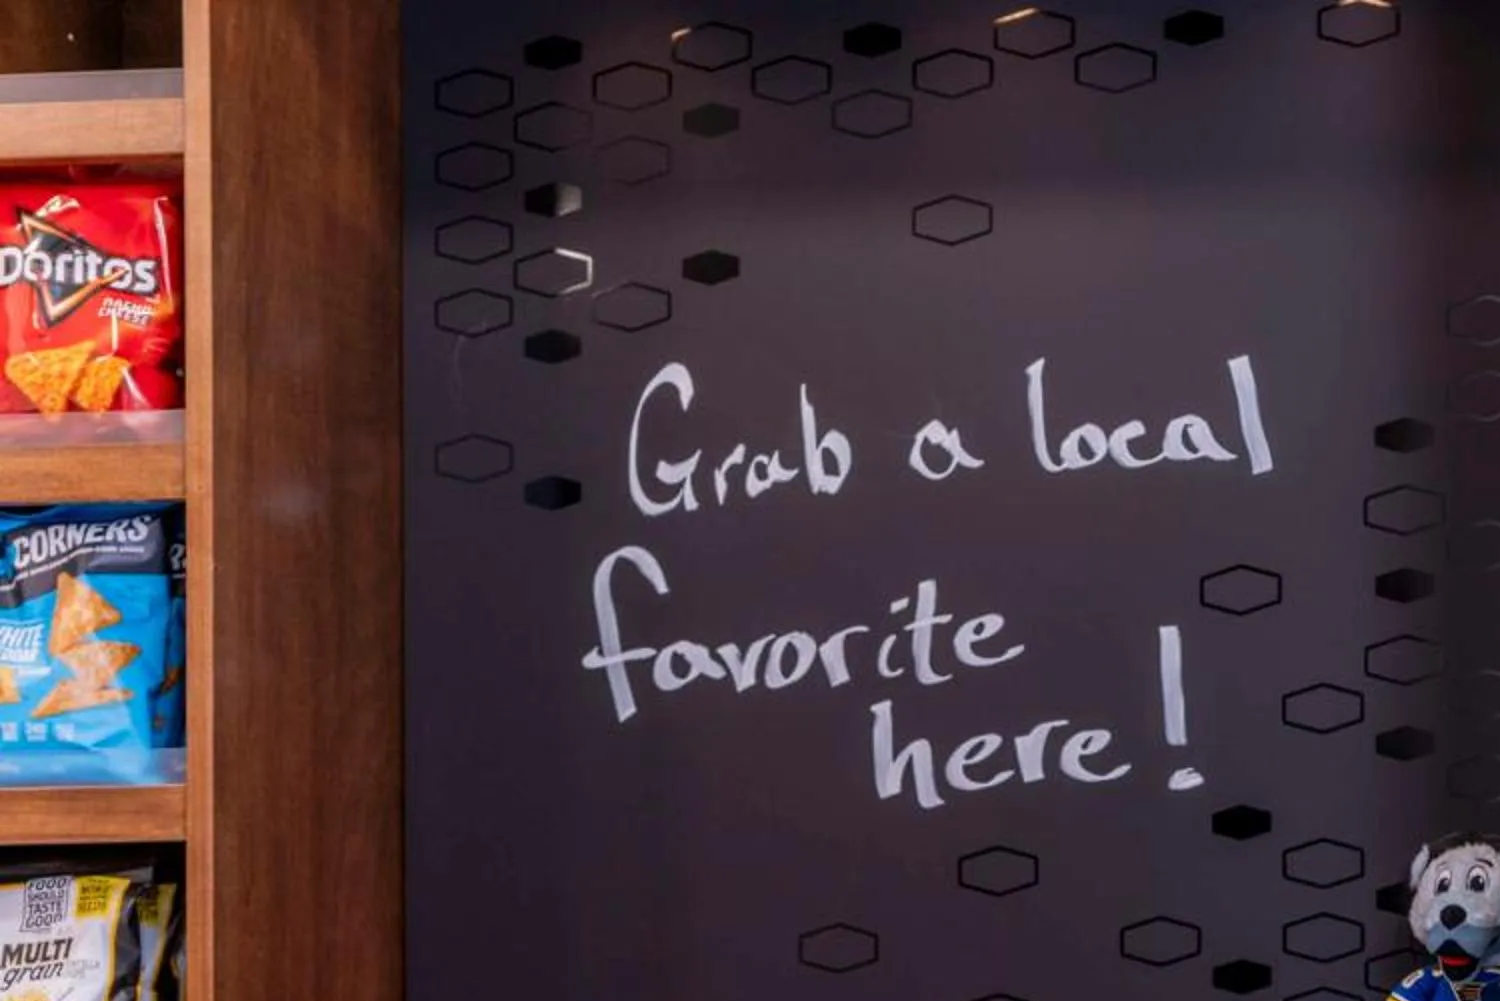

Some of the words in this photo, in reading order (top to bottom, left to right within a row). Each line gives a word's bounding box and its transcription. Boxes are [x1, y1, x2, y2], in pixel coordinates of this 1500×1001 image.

[0, 246, 158, 293] Doritos
[628, 361, 851, 515] Grab
[908, 419, 985, 480] a
[1026, 354, 1273, 475] local
[13, 515, 149, 568] CORNERS
[582, 545, 1025, 722] favorite
[0, 936, 74, 968] MULTI
[0, 961, 64, 990] grain
